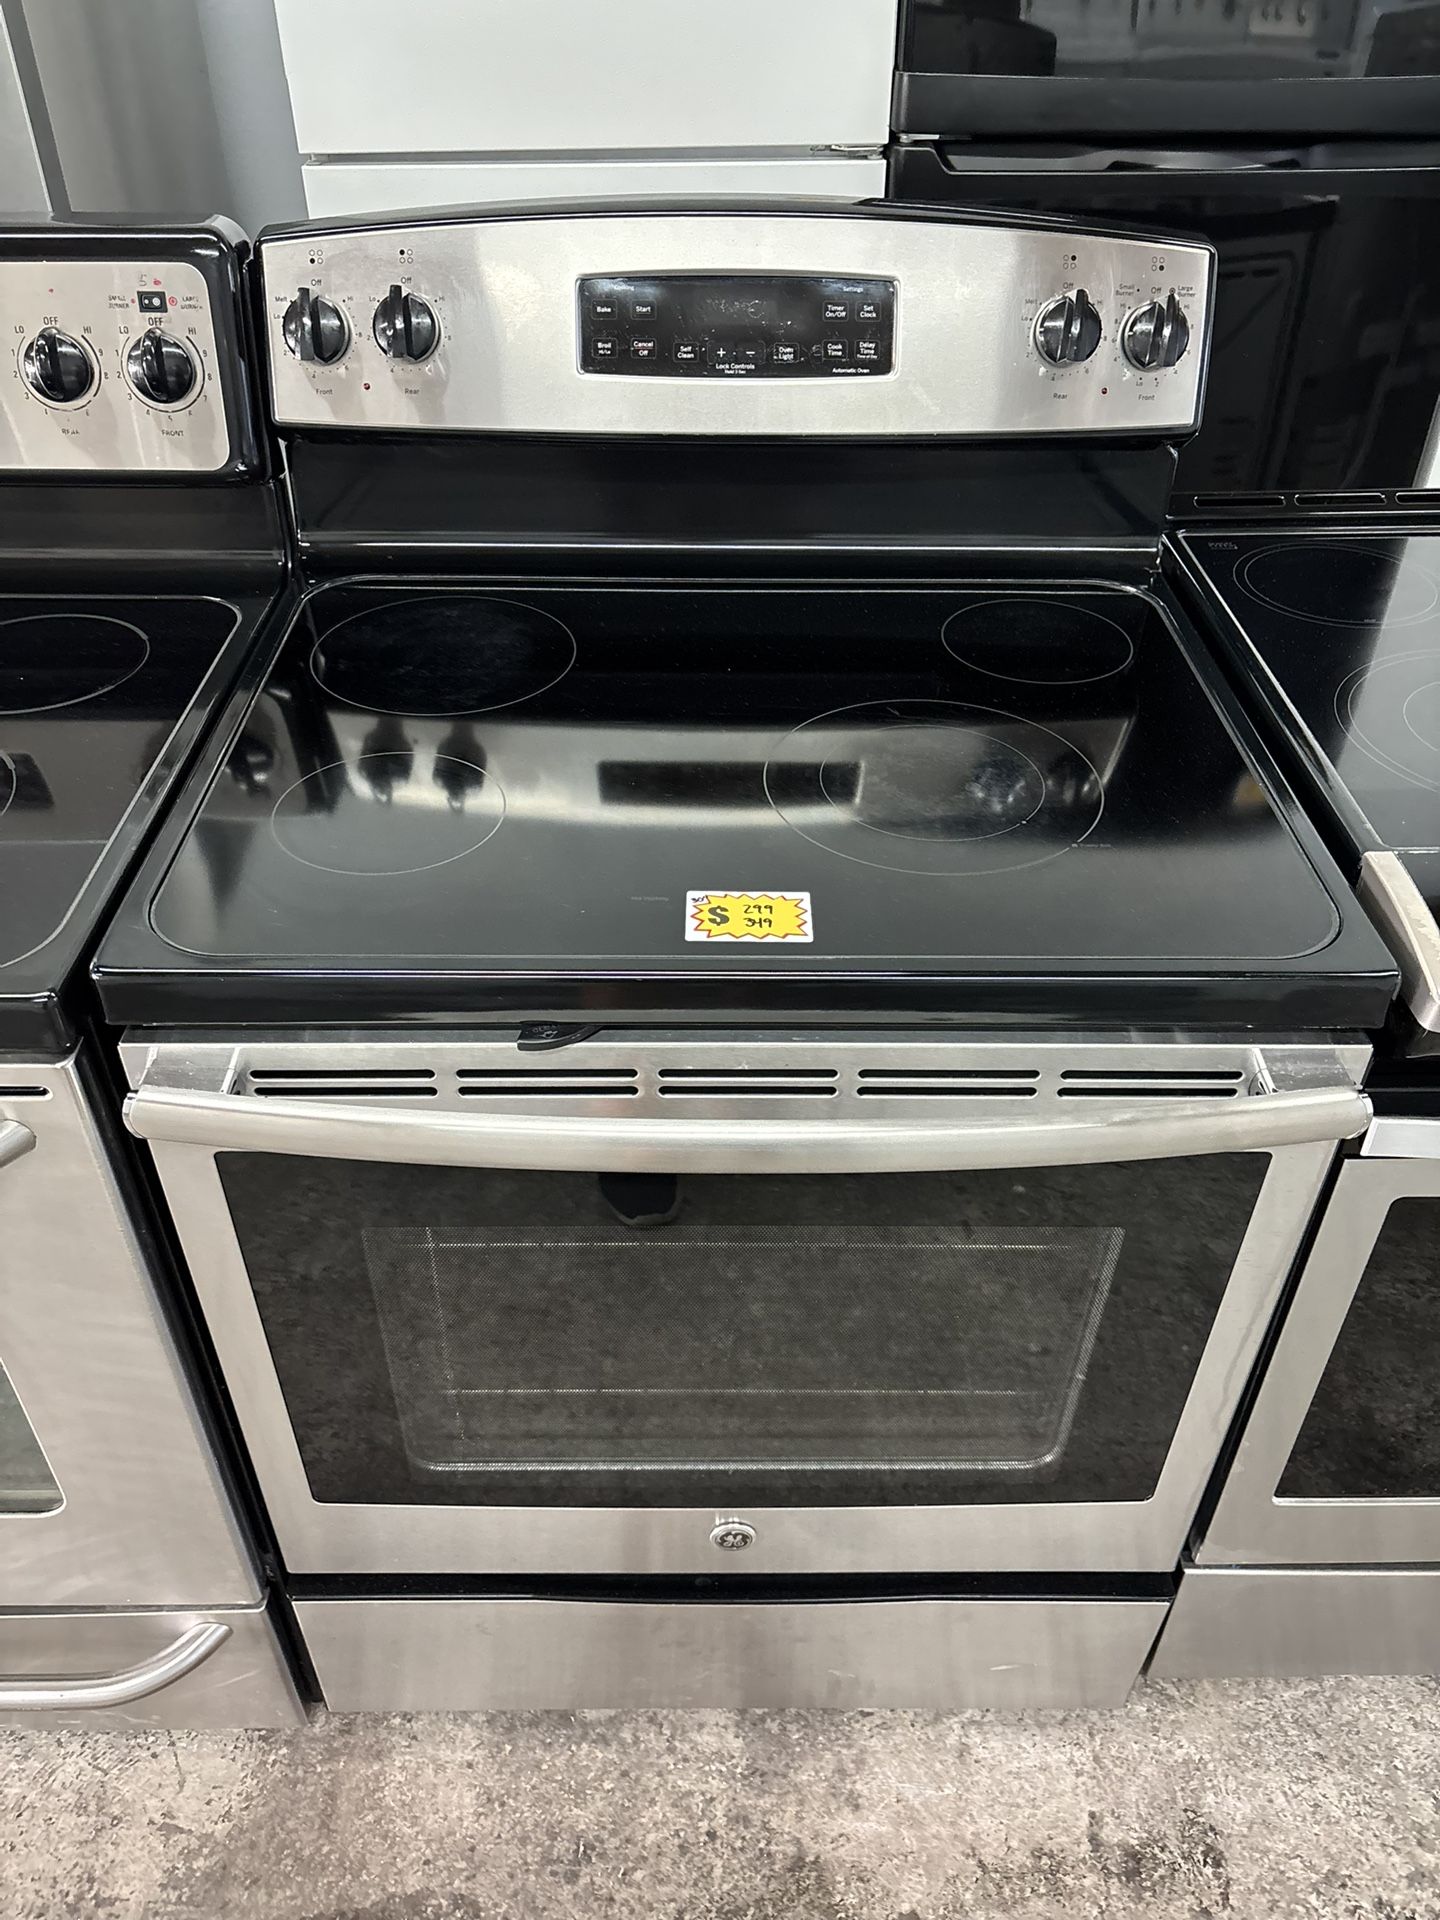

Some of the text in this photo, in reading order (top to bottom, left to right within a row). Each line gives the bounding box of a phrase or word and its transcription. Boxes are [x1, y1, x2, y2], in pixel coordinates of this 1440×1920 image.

[311, 278, 322, 287] Off
[400, 276, 412, 285] Off
[1062, 281, 1075, 290] Off
[1119, 282, 1136, 290] Small
[1177, 285, 1194, 294] Large
[1115, 289, 1136, 297] Burner
[1150, 286, 1163, 295] Off
[596, 305, 612, 313] Bake
[635, 305, 652, 313] Start
[827, 304, 845, 312] Timer
[863, 304, 874, 312] Set
[43, 316, 59, 326] OFF
[147, 317, 163, 326] OFF
[15, 325, 25, 334] LO
[83, 326, 92, 334] HI
[119, 326, 129, 335] LO
[188, 327, 197, 335] HI
[633, 340, 654, 348] Cancel
[859, 341, 876, 349] Delay
[638, 349, 649, 357] Off
[680, 345, 692, 353] Self
[778, 346, 794, 354] Oven
[827, 349, 842, 357] Time
[730, 362, 756, 370] Controls
[404, 387, 420, 395] Rear
[1053, 392, 1068, 400] Rear
[1138, 393, 1156, 401] Front
[707, 904, 774, 926] $ 299
[743, 917, 773, 929] 349
